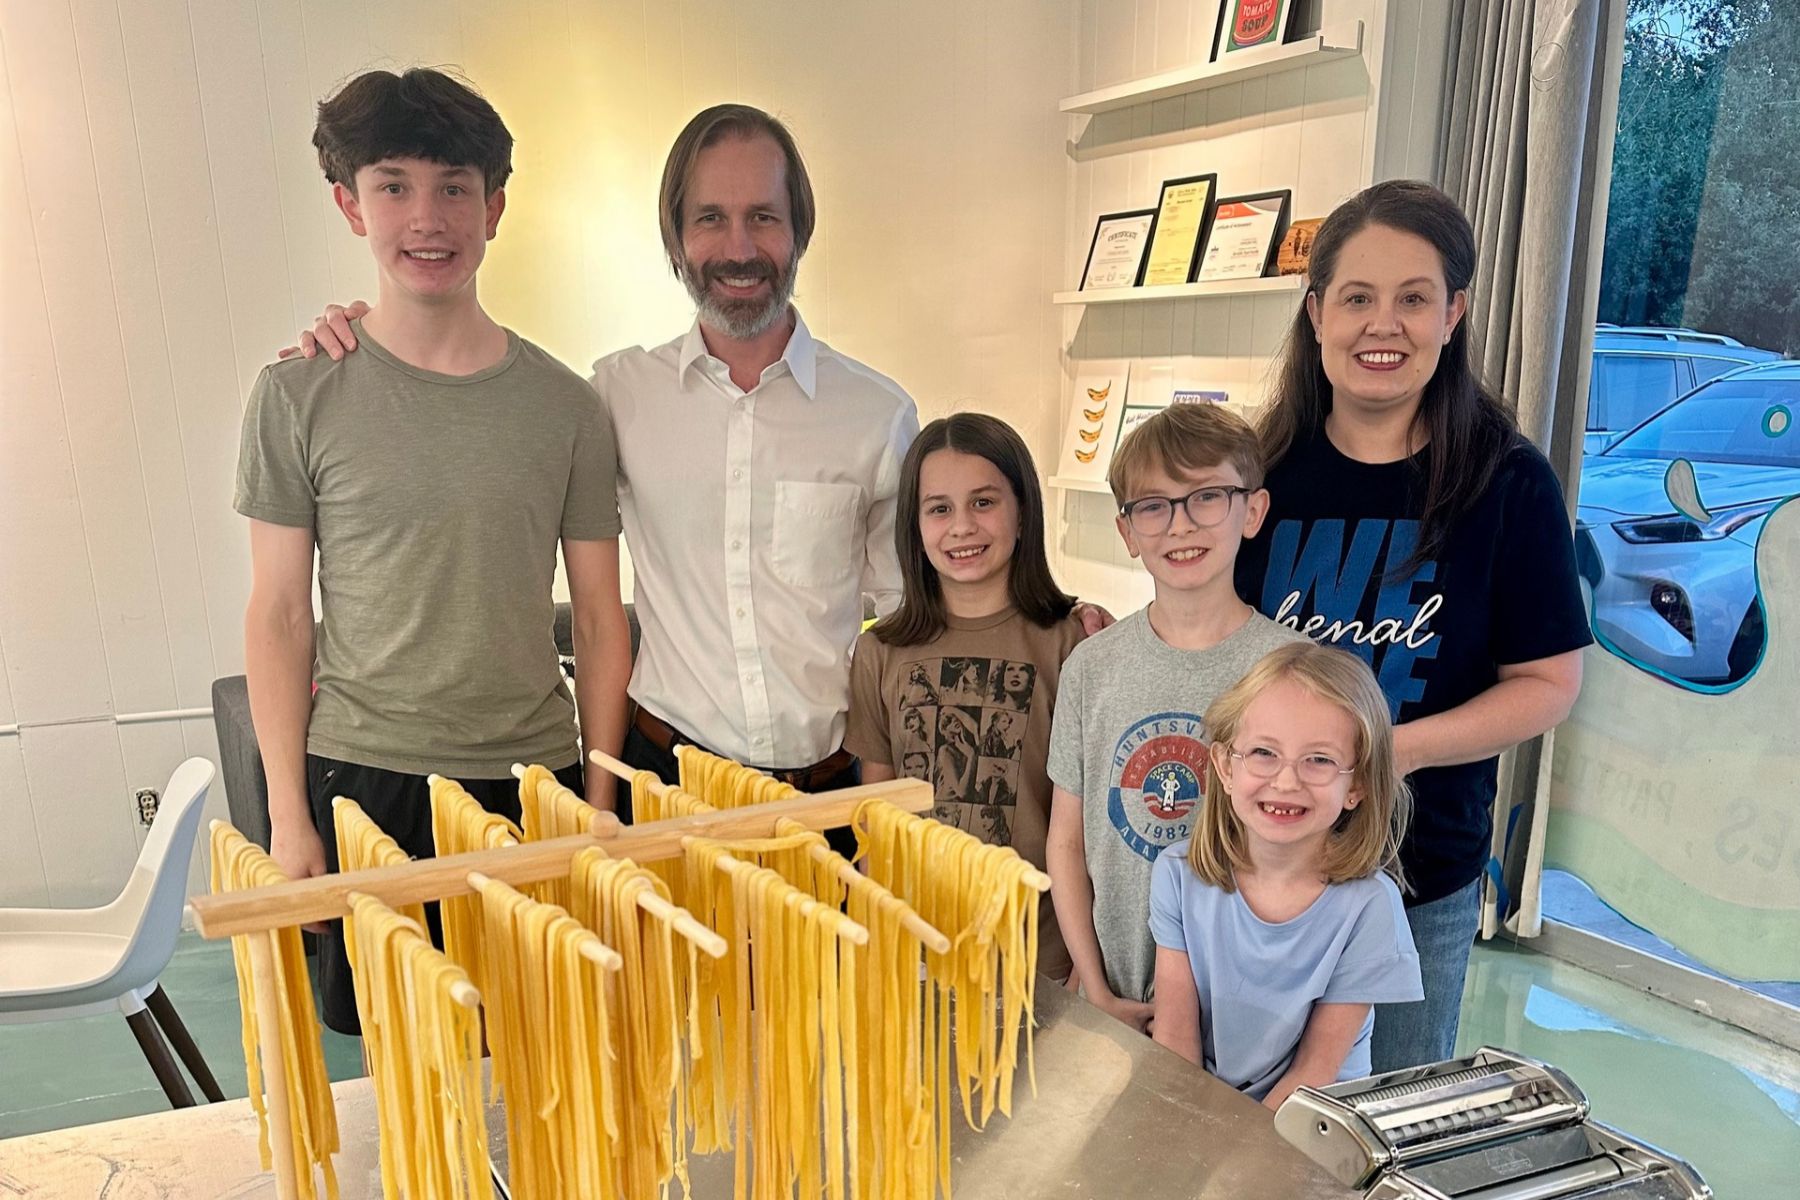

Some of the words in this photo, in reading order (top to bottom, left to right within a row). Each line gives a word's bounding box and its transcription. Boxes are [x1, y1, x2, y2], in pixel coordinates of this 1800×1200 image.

[1243, 1, 1272, 17] TOMATO
[1242, 14, 1269, 32] SOUP
[1108, 230, 1138, 242] CERTIFICATE
[1261, 518, 1438, 632] WE
[1275, 590, 1443, 649] henal
[1149, 764, 1173, 780] SPACE
[1174, 764, 1195, 784] CAMP
[1144, 822, 1190, 840] 1982
